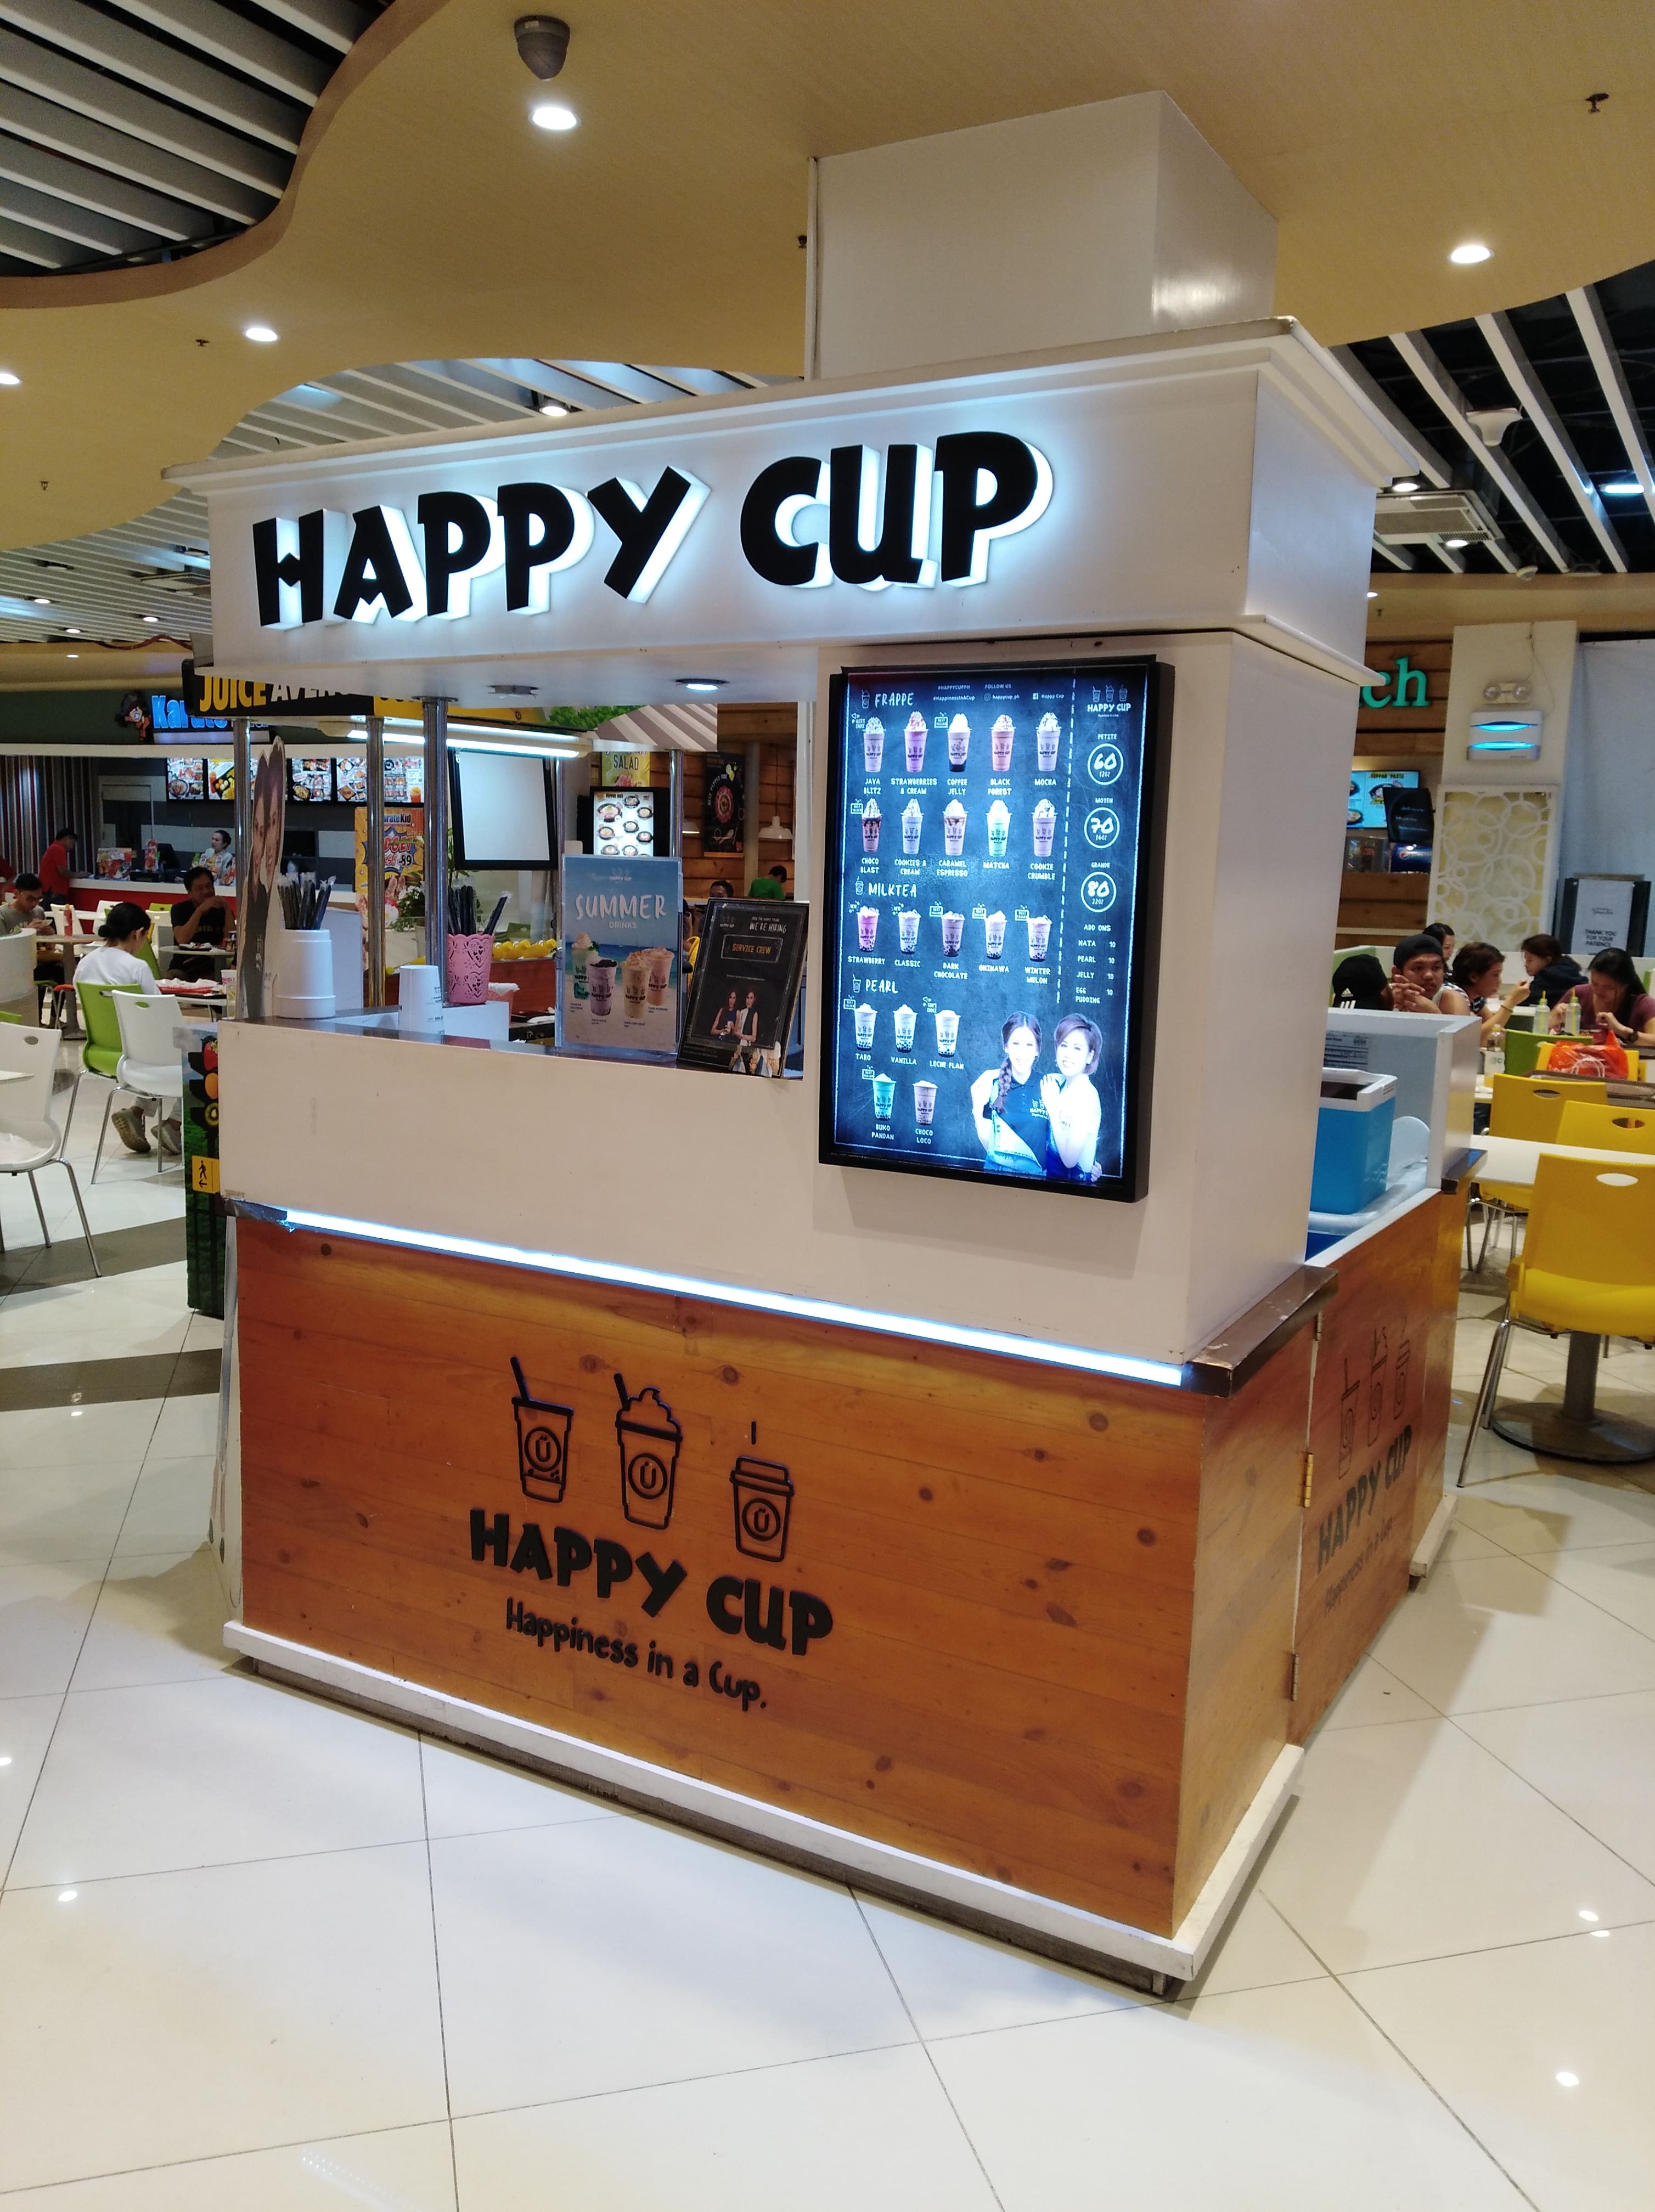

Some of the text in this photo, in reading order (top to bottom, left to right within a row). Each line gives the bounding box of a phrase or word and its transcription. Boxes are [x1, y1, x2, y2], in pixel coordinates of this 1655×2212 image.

[252, 431, 1045, 630] HAPPY CUP
[1359, 656, 1431, 709] ch
[200, 675, 266, 712] JUICE
[875, 692, 914, 708] FRAPPE
[1087, 704, 1114, 712] HAPPY
[613, 755, 639, 770] SALAD
[1094, 753, 1117, 770] 60
[401, 814, 411, 823] Kid
[1090, 817, 1113, 833] 70
[384, 836, 414, 853] DGET
[868, 882, 917, 898] MILKTEA
[1088, 881, 1110, 897] 80
[576, 894, 667, 920] SUMMER
[769, 924, 786, 933] HIRING
[732, 944, 772, 954] SERVICE CREW
[848, 956, 885, 964] STRAWBERRY
[934, 971, 968, 979] CHOCOLATE
[978, 964, 1009, 973] OKINAWA
[1025, 967, 1050, 975] WINTER
[865, 979, 898, 994] PEARL
[1076, 996, 1100, 1004] PUDDING
[891, 1056, 917, 1065] VANILLA
[948, 1062, 964, 1070] FLAN
[871, 1132, 894, 1140] PANDAN
[1318, 1460, 1381, 1575] HAPPY
[1385, 1425, 1412, 1490] CUP
[470, 1509, 833, 1656] HAPPY CUP
[506, 1598, 767, 1712] Happiness in a Cup.
